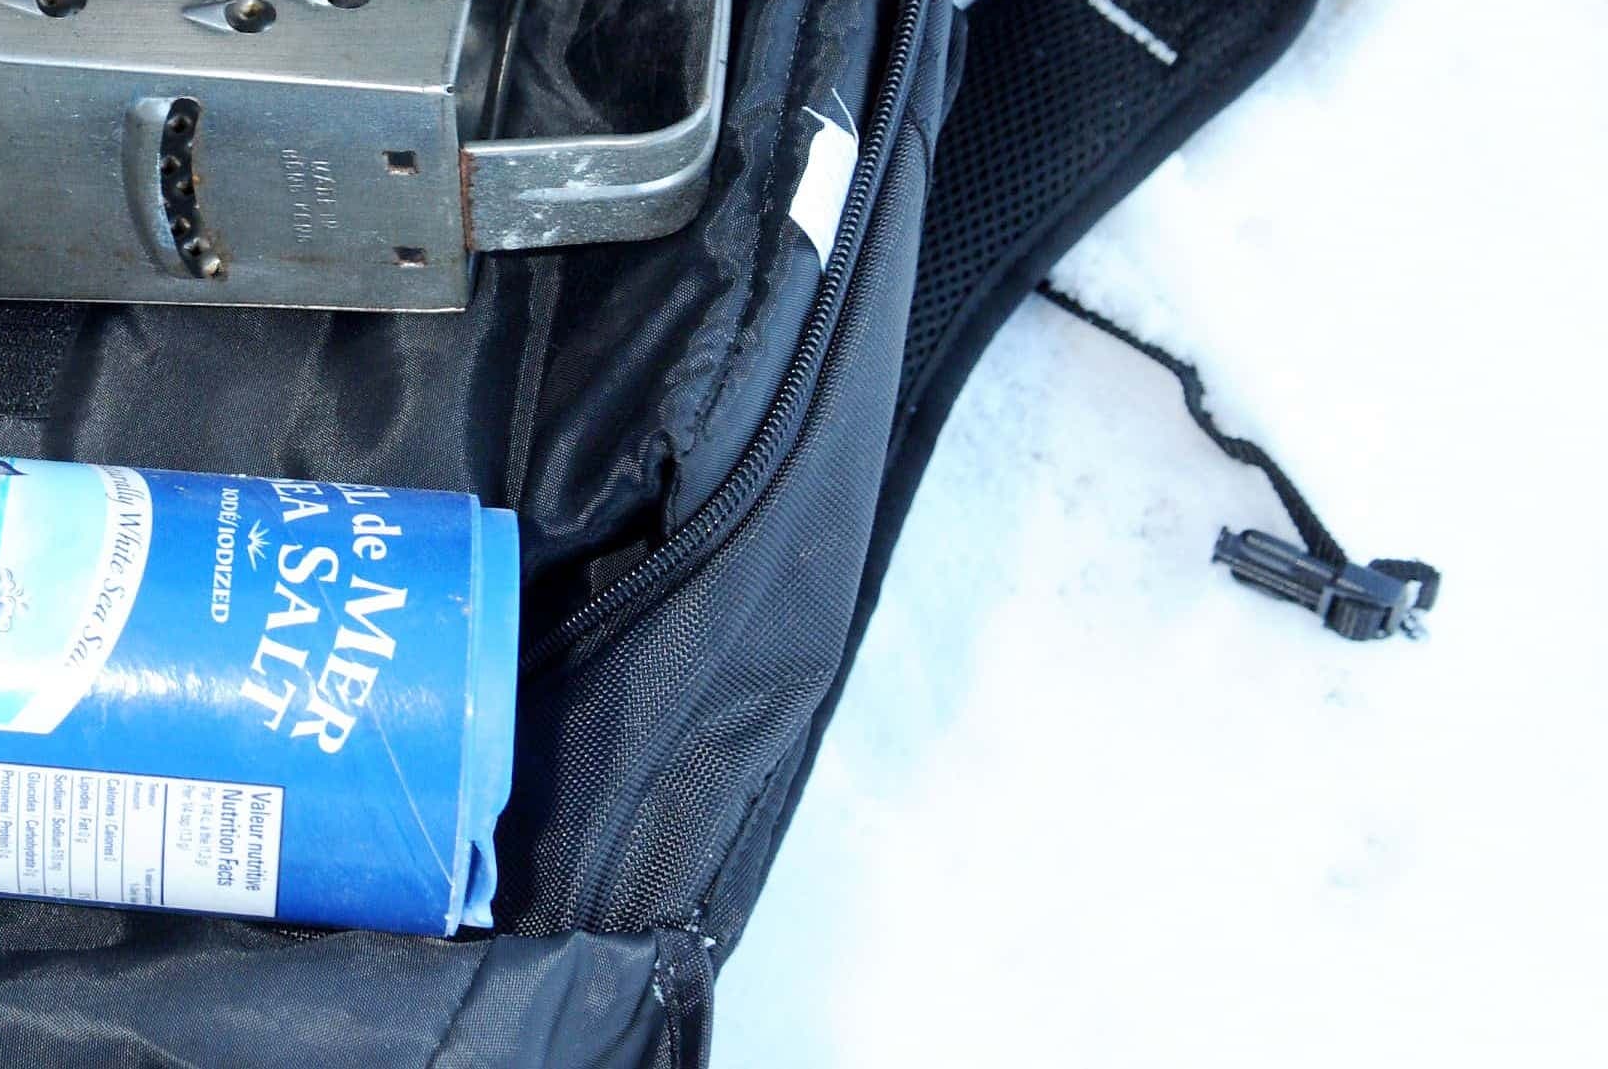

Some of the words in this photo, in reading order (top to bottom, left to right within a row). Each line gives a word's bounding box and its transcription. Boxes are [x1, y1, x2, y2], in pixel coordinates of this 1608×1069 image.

[330, 483, 391, 505] EL
[110, 512, 143, 574] White
[352, 513, 403, 561] de
[91, 578, 126, 623] Sea
[238, 543, 340, 732] SALT
[290, 574, 409, 755] MER
[26, 771, 42, 812] Glucides
[53, 773, 68, 810] Sodium
[77, 775, 92, 810] Lipides
[105, 778, 122, 817] Calories
[51, 817, 66, 849] Sodium
[78, 818, 92, 831] Fat
[218, 788, 244, 855] Nutrition
[249, 792, 273, 840] Valeur
[216, 857, 239, 887] Facts
[245, 842, 268, 892] nutritive
